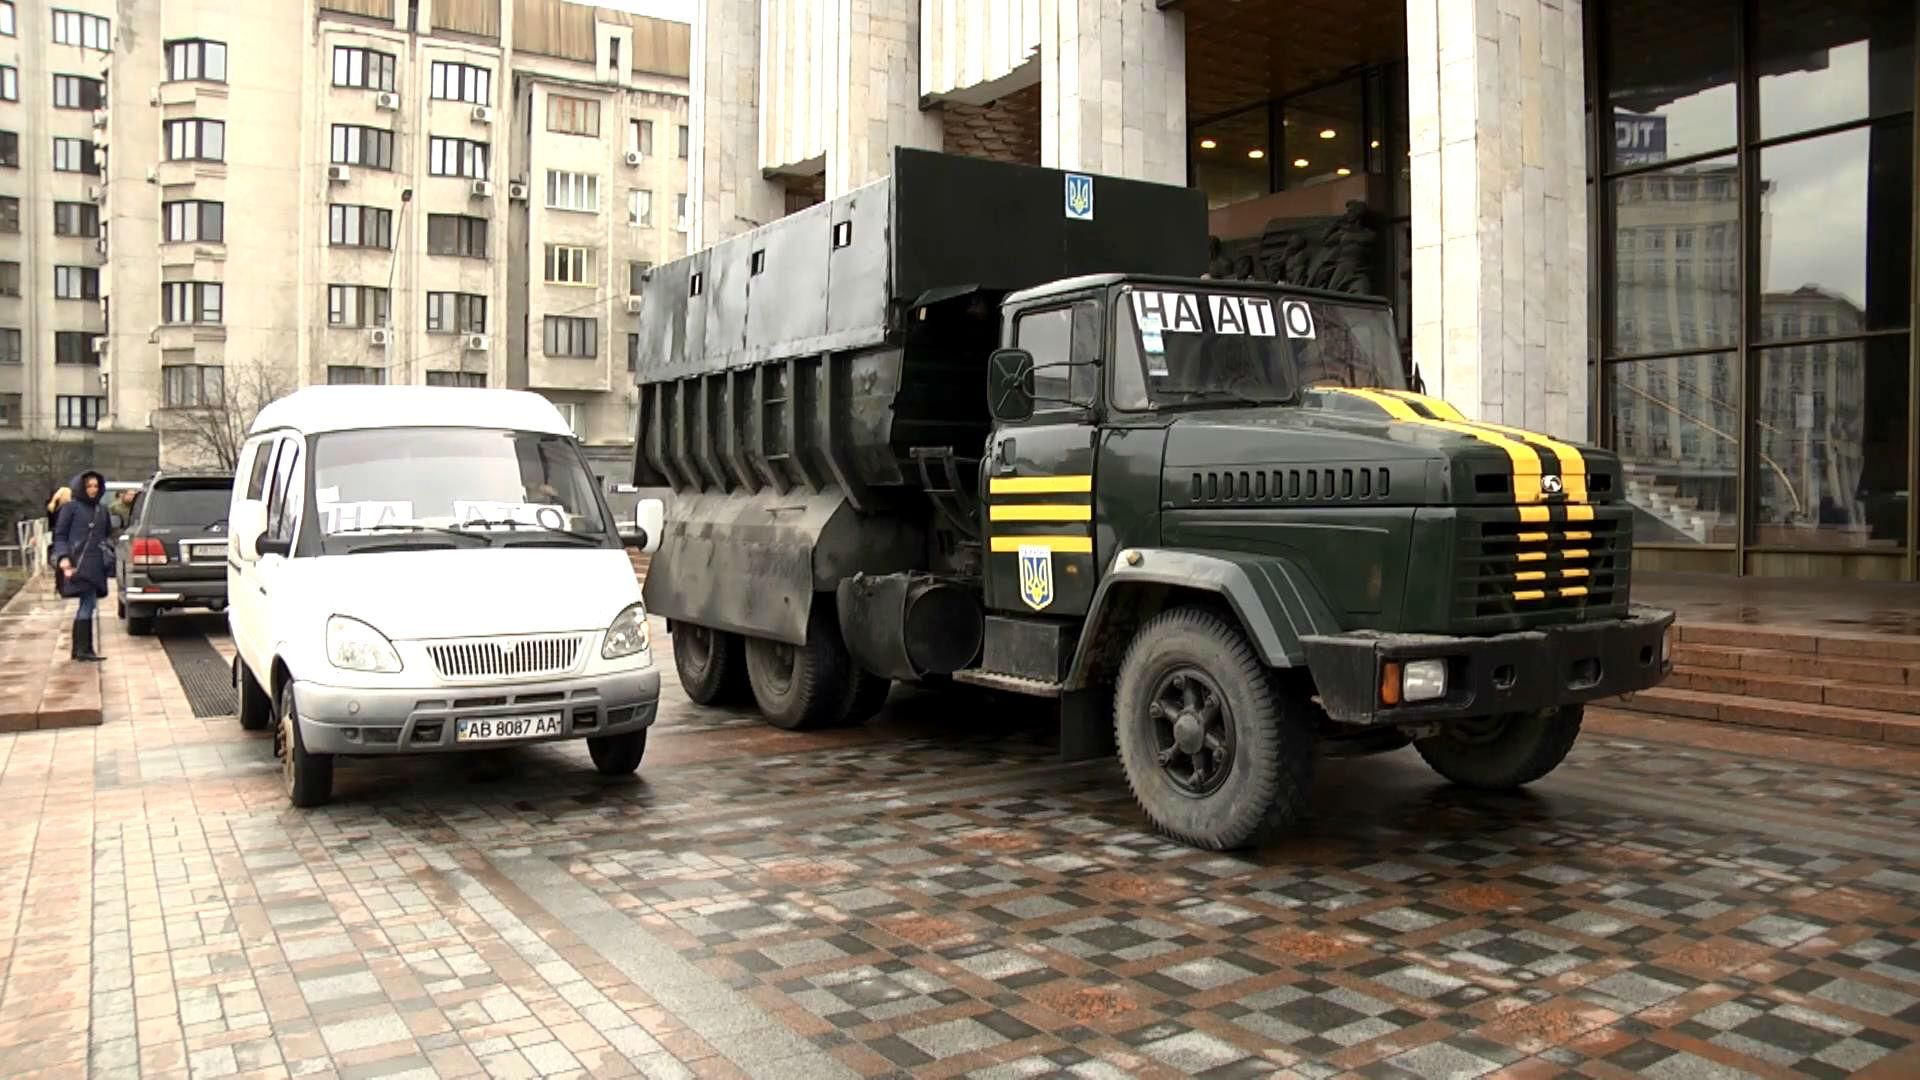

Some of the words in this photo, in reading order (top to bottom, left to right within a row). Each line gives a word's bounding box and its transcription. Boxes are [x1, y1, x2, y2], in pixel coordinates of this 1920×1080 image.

[1139, 292, 1201, 330] НА
[1217, 296, 1312, 336] АТО
[496, 719, 532, 736] 8087
